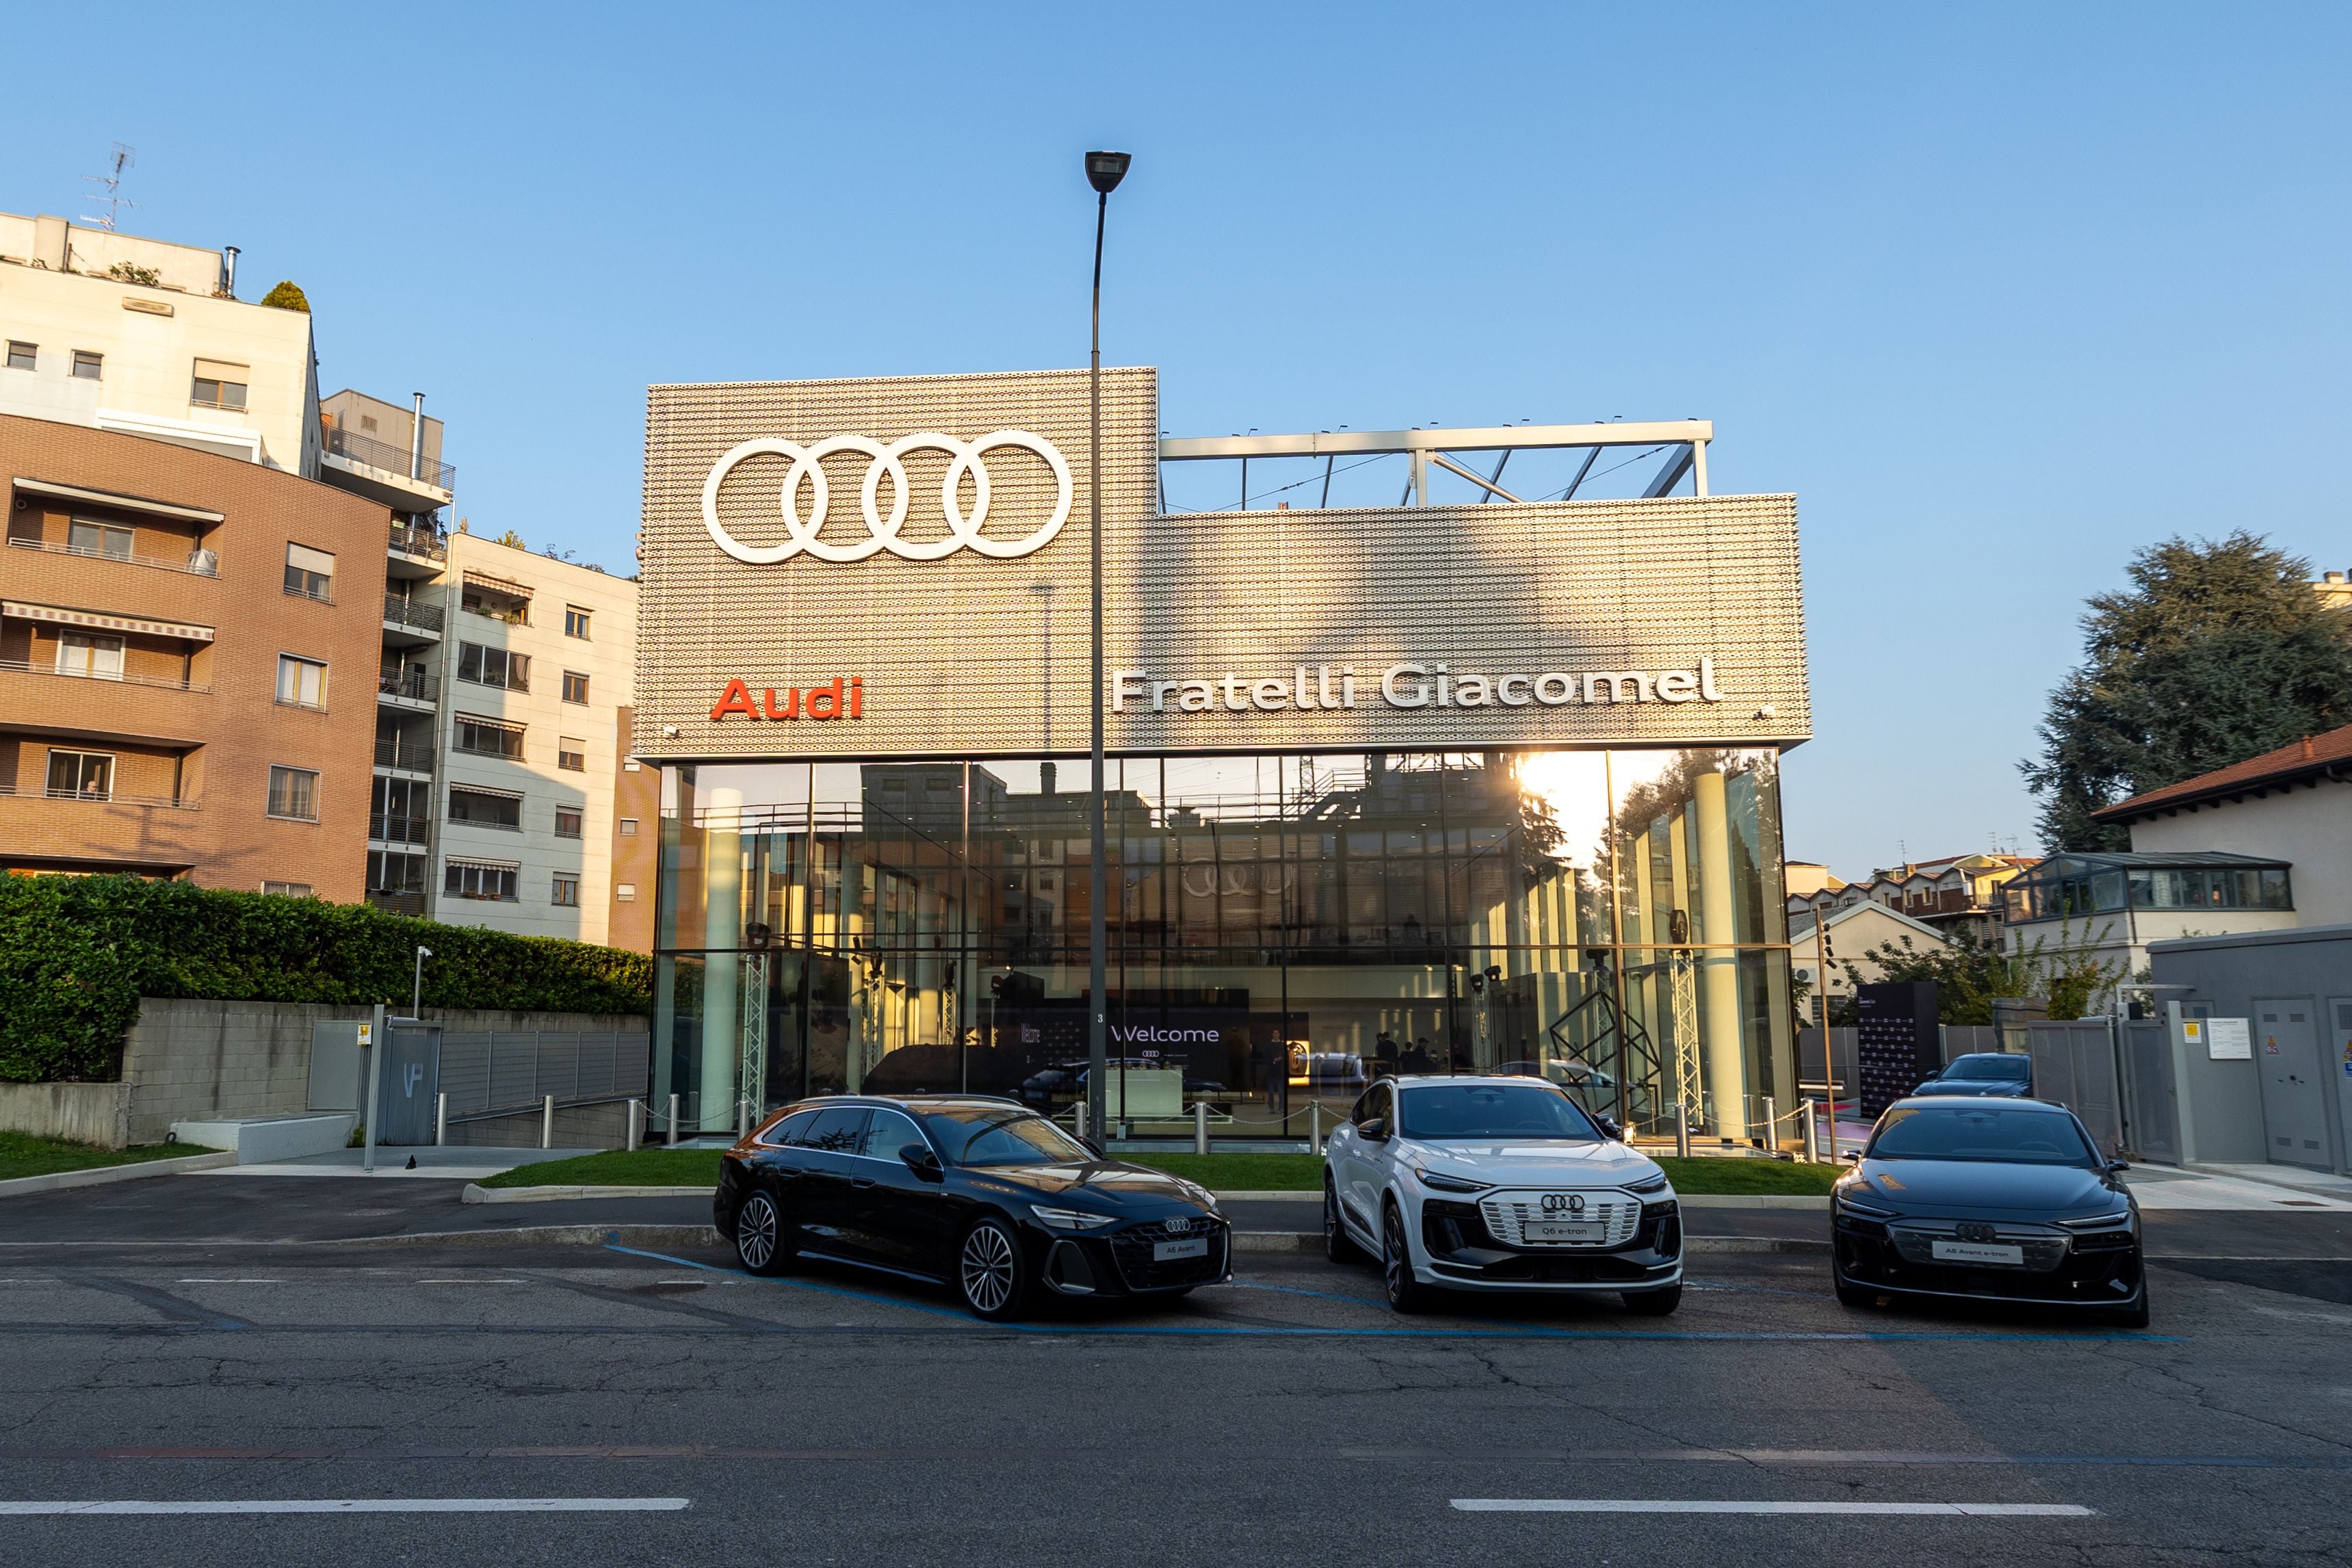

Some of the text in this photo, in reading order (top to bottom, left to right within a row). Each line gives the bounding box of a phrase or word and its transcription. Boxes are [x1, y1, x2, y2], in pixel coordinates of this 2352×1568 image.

[710, 676, 863, 720] Audi
[1113, 656, 1723, 713] Fratelli Giacomel
[1097, 1013, 1103, 1023] 3
[1111, 1025, 1220, 1042] Welcome
